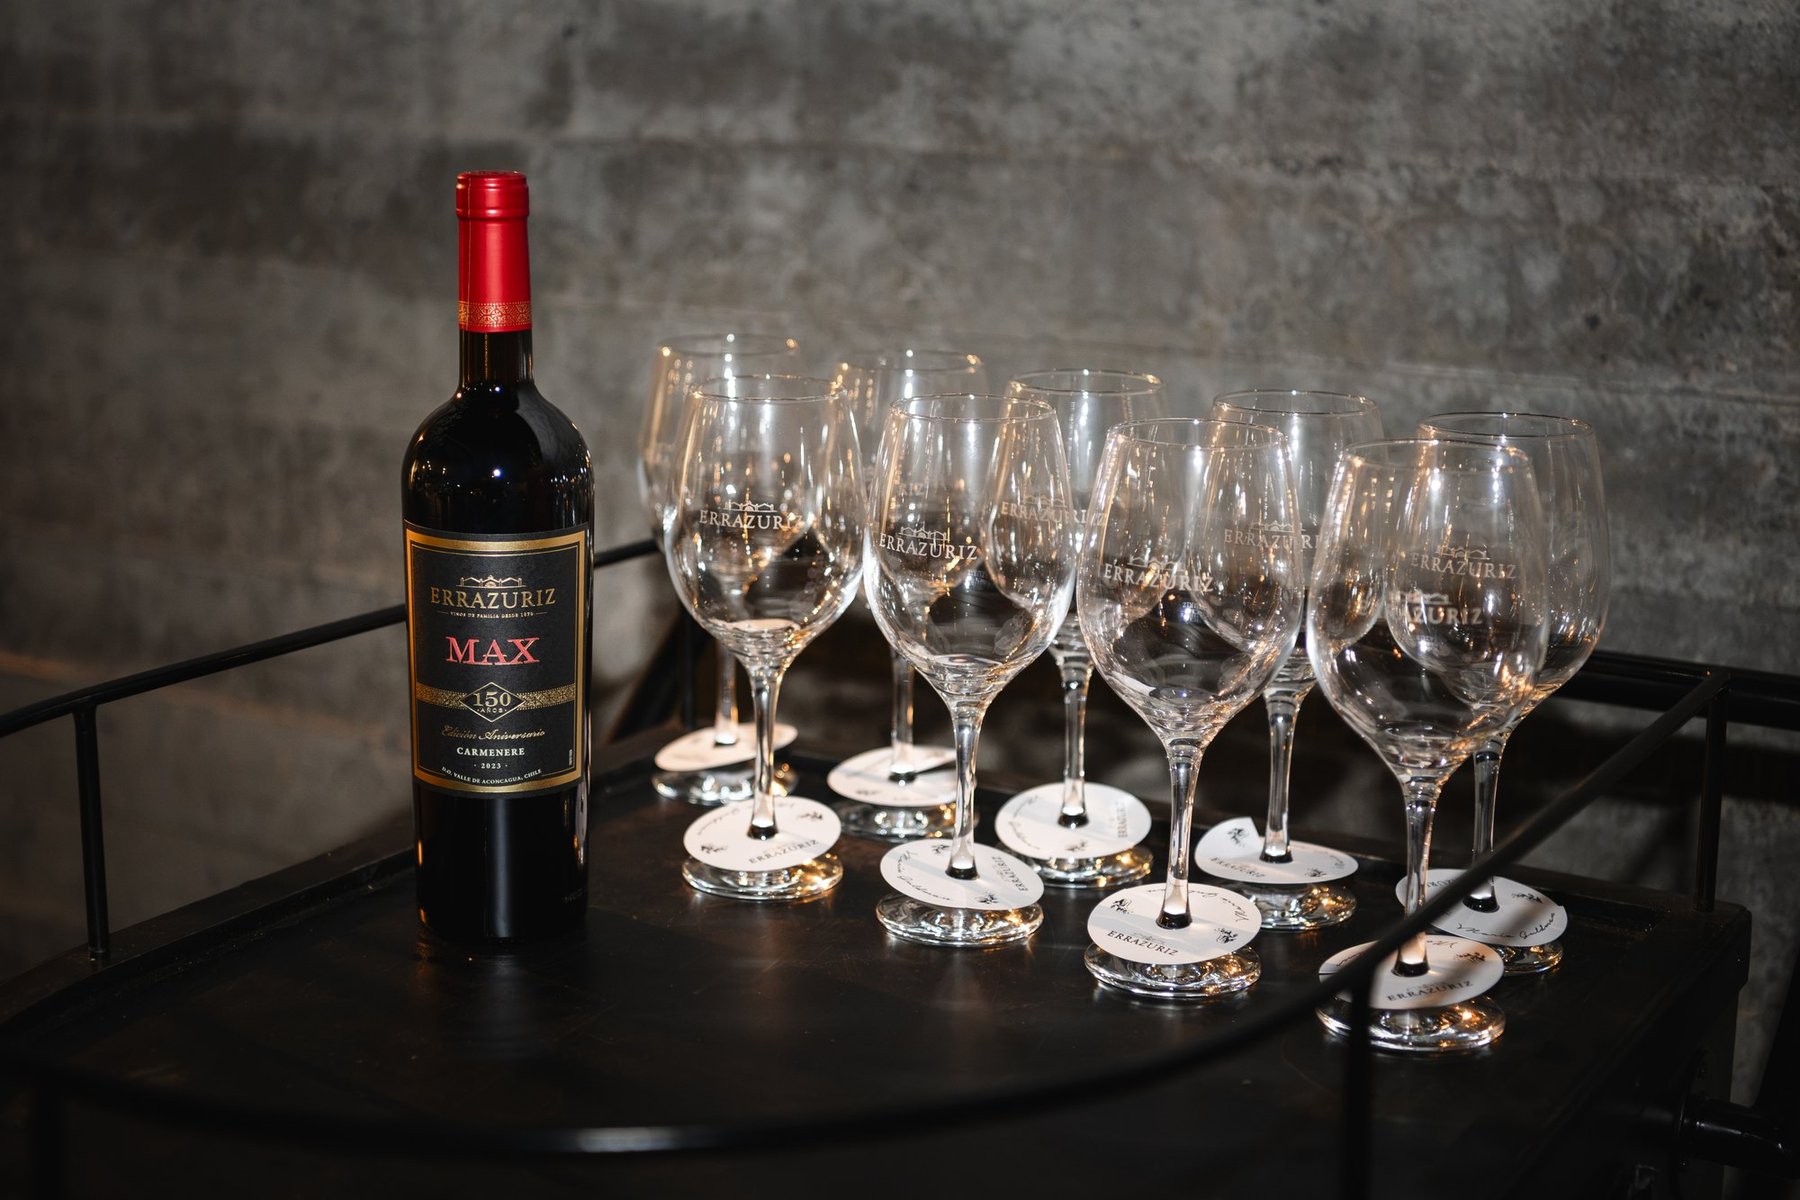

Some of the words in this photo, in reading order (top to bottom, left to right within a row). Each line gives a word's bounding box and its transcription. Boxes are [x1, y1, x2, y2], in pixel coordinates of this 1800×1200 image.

[879, 532, 978, 560] ERRAZURIZ
[1103, 562, 1214, 592] ERRAZURIZ
[1410, 552, 1519, 579] ERRAZURIZ
[430, 586, 557, 610] ERRAZURIZ
[445, 636, 540, 666] MAX
[473, 691, 512, 707] 150
[441, 724, 478, 740] Edición
[478, 728, 546, 740] Aniversario
[456, 746, 525, 757] CARMENERE
[453, 771, 471, 782] VALLE
[482, 776, 524, 785] ACONCAGUA,
[524, 768, 542, 779] CHILE
[748, 839, 819, 864] ERRAZURIZ
[1107, 930, 1179, 956] ERRAZURIZ
[1387, 980, 1473, 1002] ERRAZURIZ
